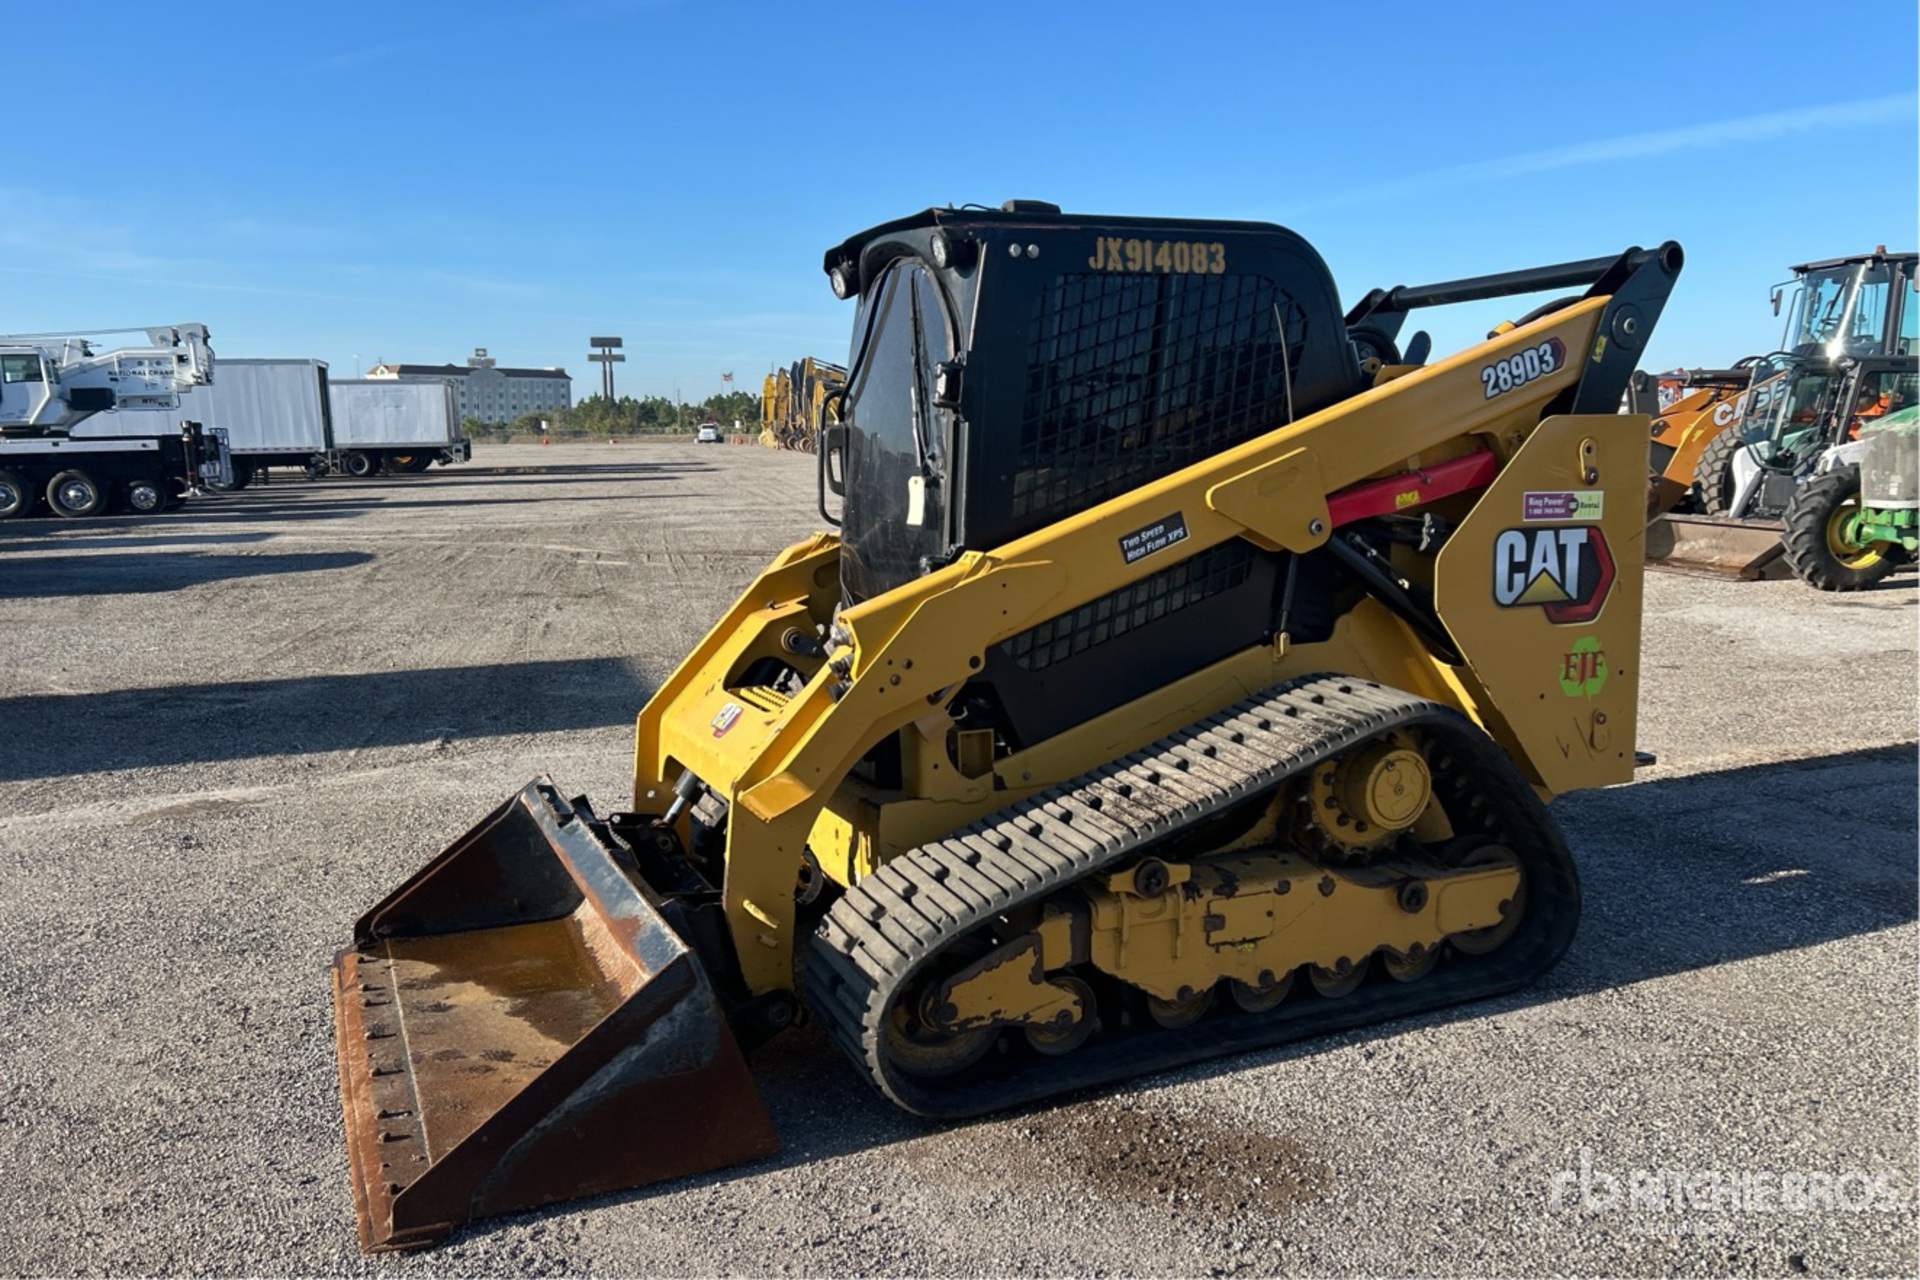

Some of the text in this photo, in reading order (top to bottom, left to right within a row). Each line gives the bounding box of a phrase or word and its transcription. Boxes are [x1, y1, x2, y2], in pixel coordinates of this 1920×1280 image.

[1088, 237, 1226, 274] JX914083
[1482, 342, 1556, 399] 289D3
[1167, 527, 1184, 543] XPS
[1496, 528, 1588, 605] CAT
[1562, 650, 1605, 686] FJF
